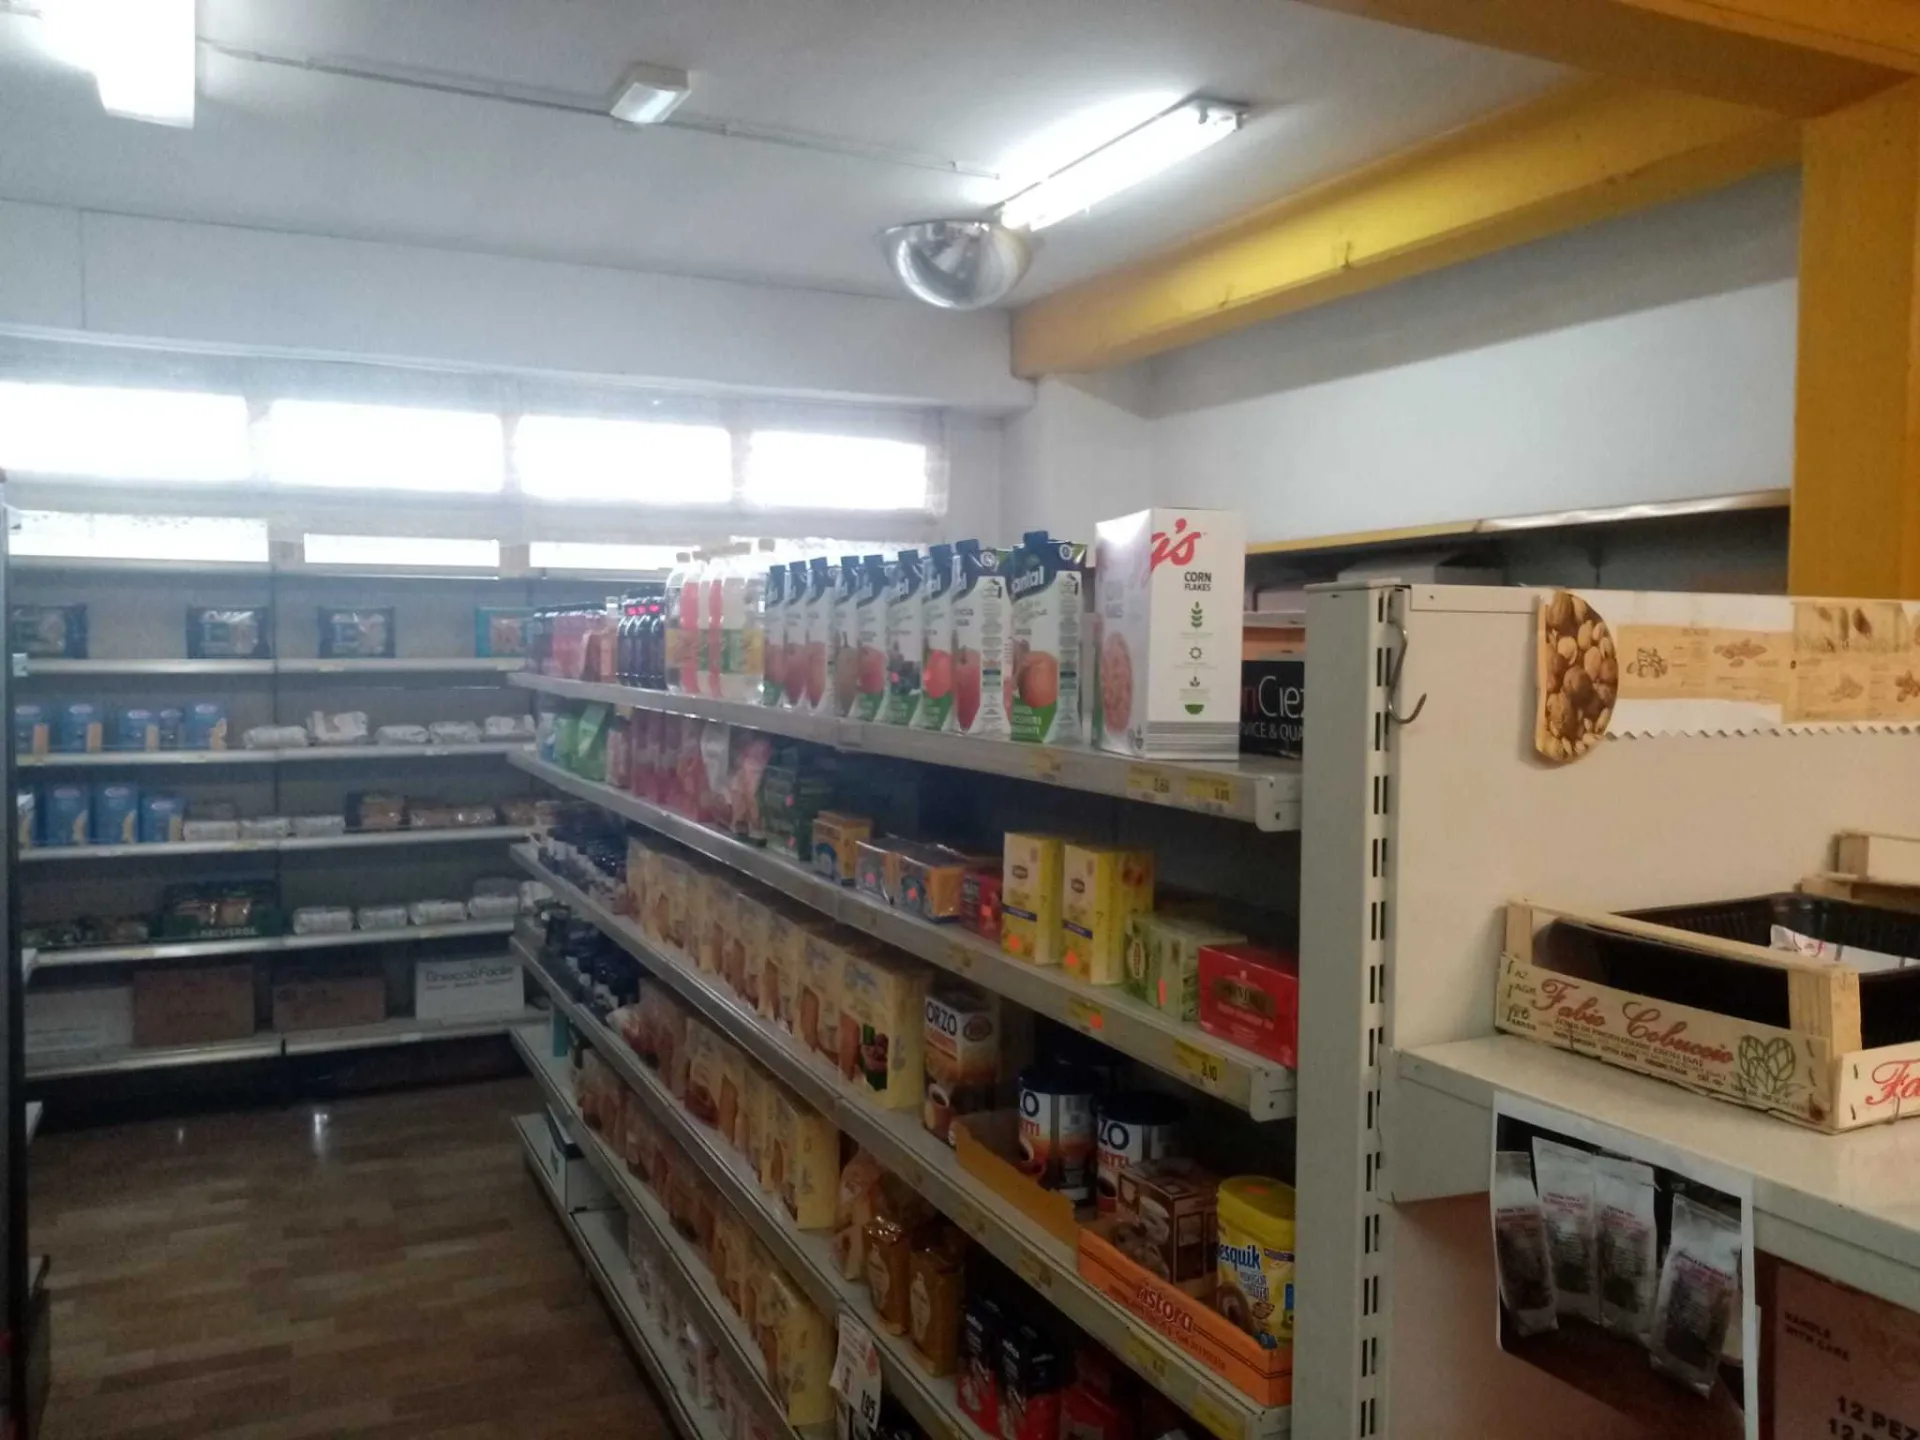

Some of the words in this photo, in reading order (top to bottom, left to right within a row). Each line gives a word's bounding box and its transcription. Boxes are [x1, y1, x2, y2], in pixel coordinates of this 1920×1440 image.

[1184, 571, 1212, 583] CORN
[1184, 583, 1212, 592] FLAKES
[1269, 723, 1278, 739] &
[1530, 977, 1606, 1027] Fabio
[925, 1001, 958, 1037] ORZO
[1837, 1395, 1865, 1423] 12
